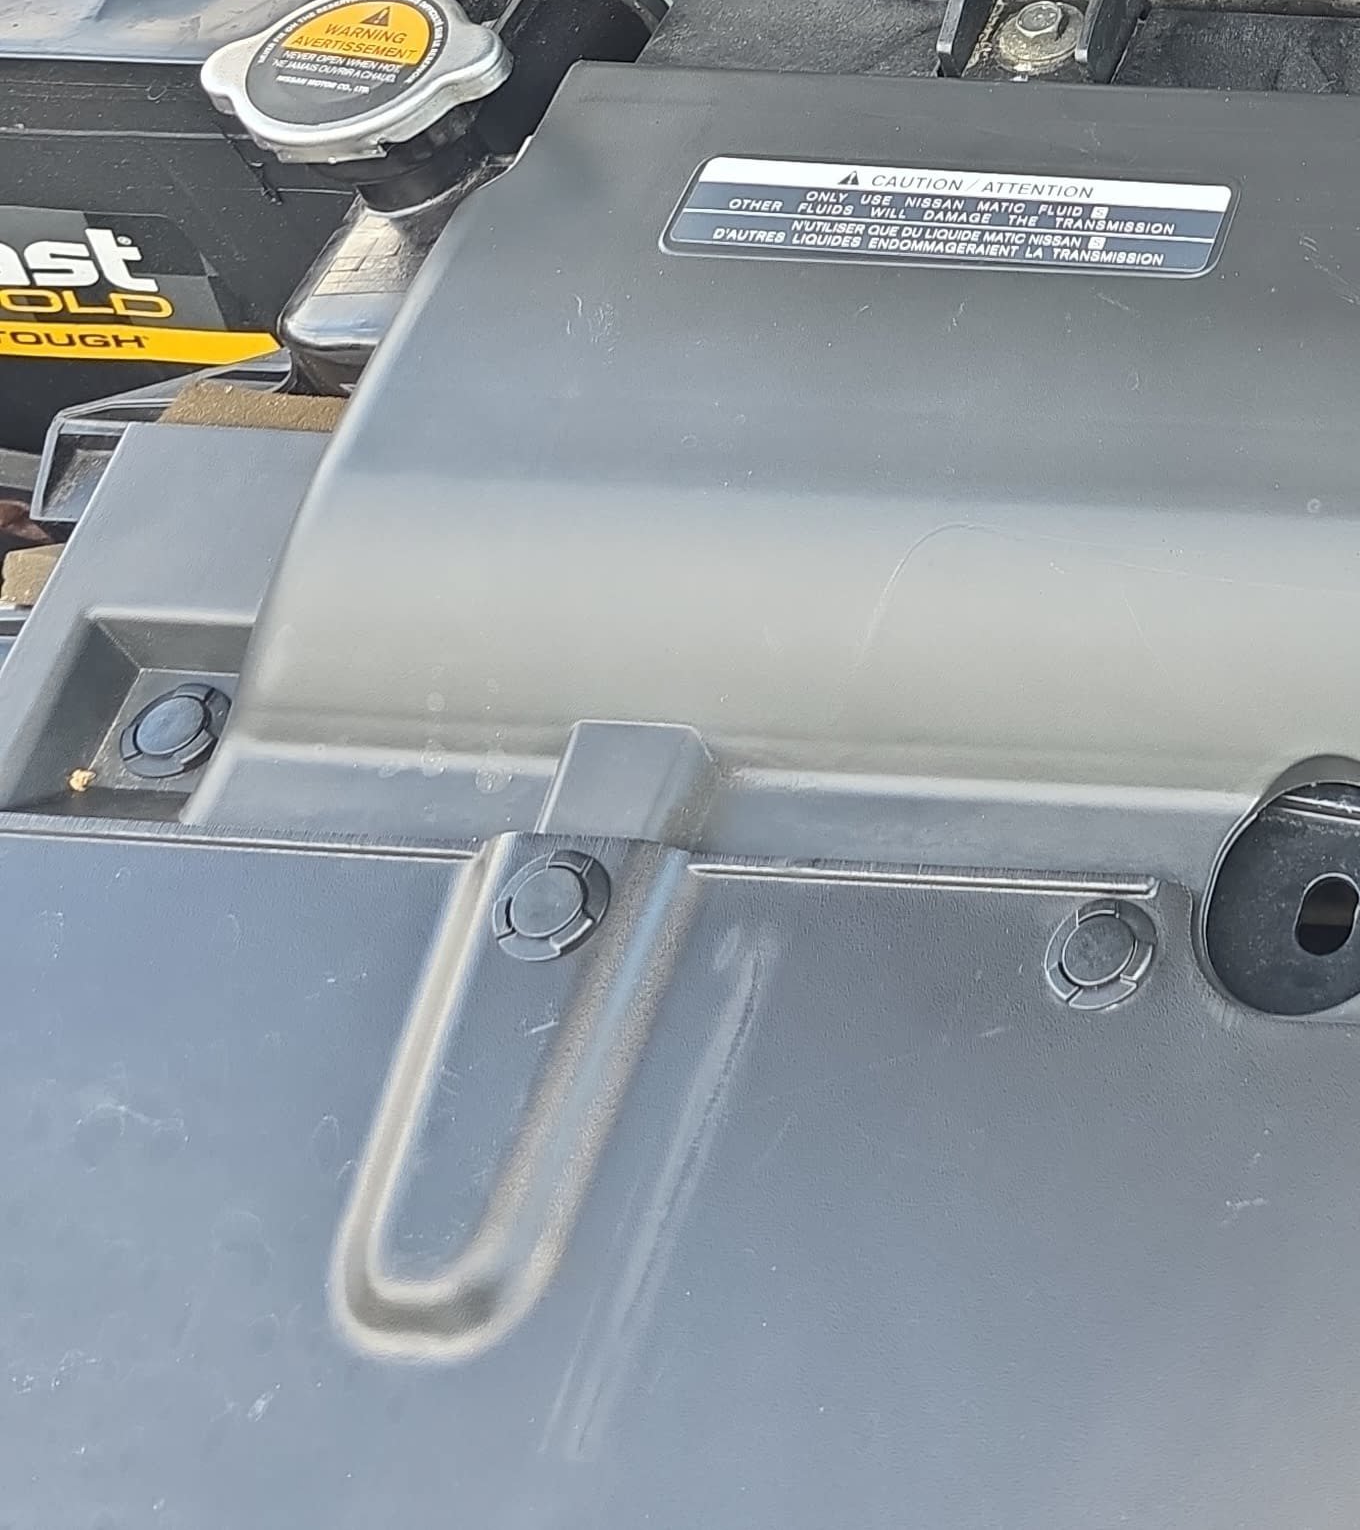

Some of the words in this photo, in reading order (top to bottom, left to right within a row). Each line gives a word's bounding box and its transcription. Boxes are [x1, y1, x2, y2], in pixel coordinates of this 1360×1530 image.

[325, 24, 407, 44] WARNING
[283, 50, 318, 61] NEVER
[317, 54, 346, 64] OPEN
[346, 57, 378, 70] WHEN
[292, 36, 417, 59] AVERTISSEMENT
[871, 174, 964, 192] CAUTION
[982, 181, 1094, 200] ATTENTION
[728, 198, 784, 211] OTHER
[797, 203, 854, 216] FLUIDS
[869, 207, 907, 219] WILL
[923, 209, 992, 224] DAMAGE
[1008, 215, 1039, 227] THE
[1055, 218, 1175, 235] TRANSMISSION
[806, 191, 849, 203] ONLY
[860, 195, 892, 206] USE
[904, 196, 965, 210] NISSAN
[976, 201, 1026, 214] MATIC
[1038, 204, 1083, 217] FLUID
[713, 228, 785, 243] D'AUTRES
[792, 233, 862, 248] LIQUIDES
[868, 236, 1019, 259] ENDOMMAGERAIENT
[1025, 246, 1044, 258] LA
[1052, 248, 1165, 266] TRANSMISSION
[791, 220, 866, 235] N'UTILISER
[868, 225, 899, 237] QUE
[901, 227, 923, 238] DU
[925, 227, 979, 242] LIQUIDE
[983, 231, 1026, 245] MATIC
[1028, 234, 1082, 248] NISSAN
[0, 331, 146, 348] OUGH
